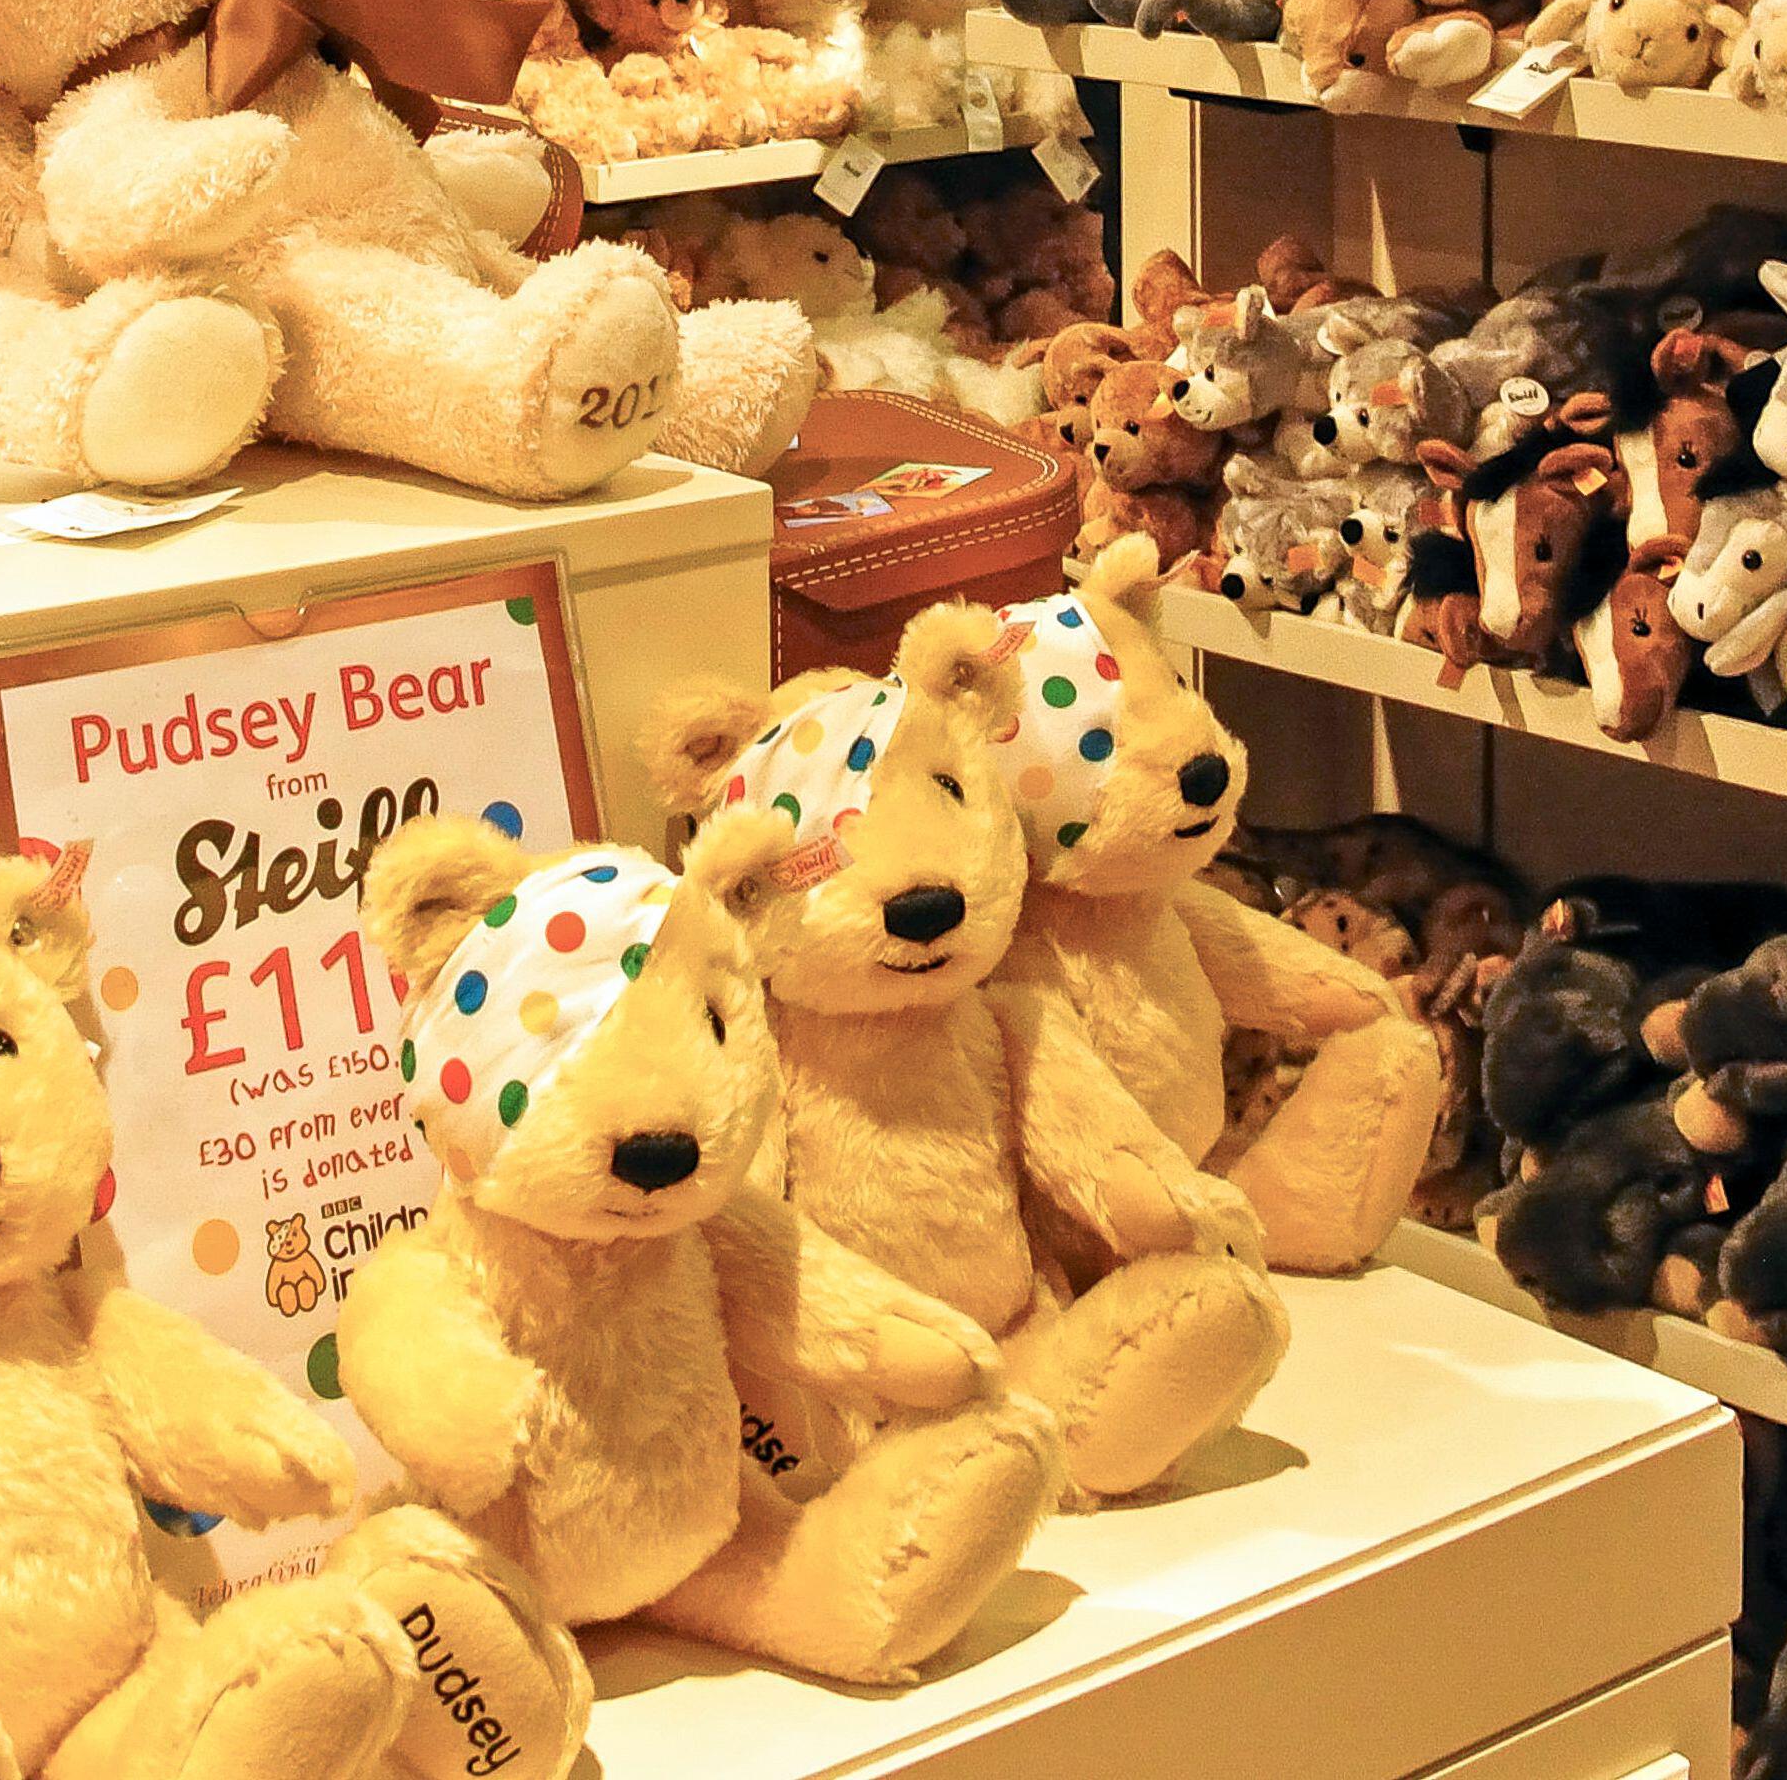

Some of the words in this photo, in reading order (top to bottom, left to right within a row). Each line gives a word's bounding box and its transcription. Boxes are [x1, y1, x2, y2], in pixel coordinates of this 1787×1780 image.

[579, 374, 669, 429] 201
[71, 692, 316, 783] Pudsey
[339, 658, 491, 731] Bear
[266, 772, 328, 801] from
[181, 931, 409, 1075] £11
[230, 1063, 314, 1105] (was
[200, 1132, 257, 1167] £30
[350, 1093, 412, 1129] ever
[262, 1169, 288, 1200] is
[303, 1134, 414, 1188] donated
[321, 1196, 363, 1219] BBC
[400, 1603, 521, 1777] Pudsey
